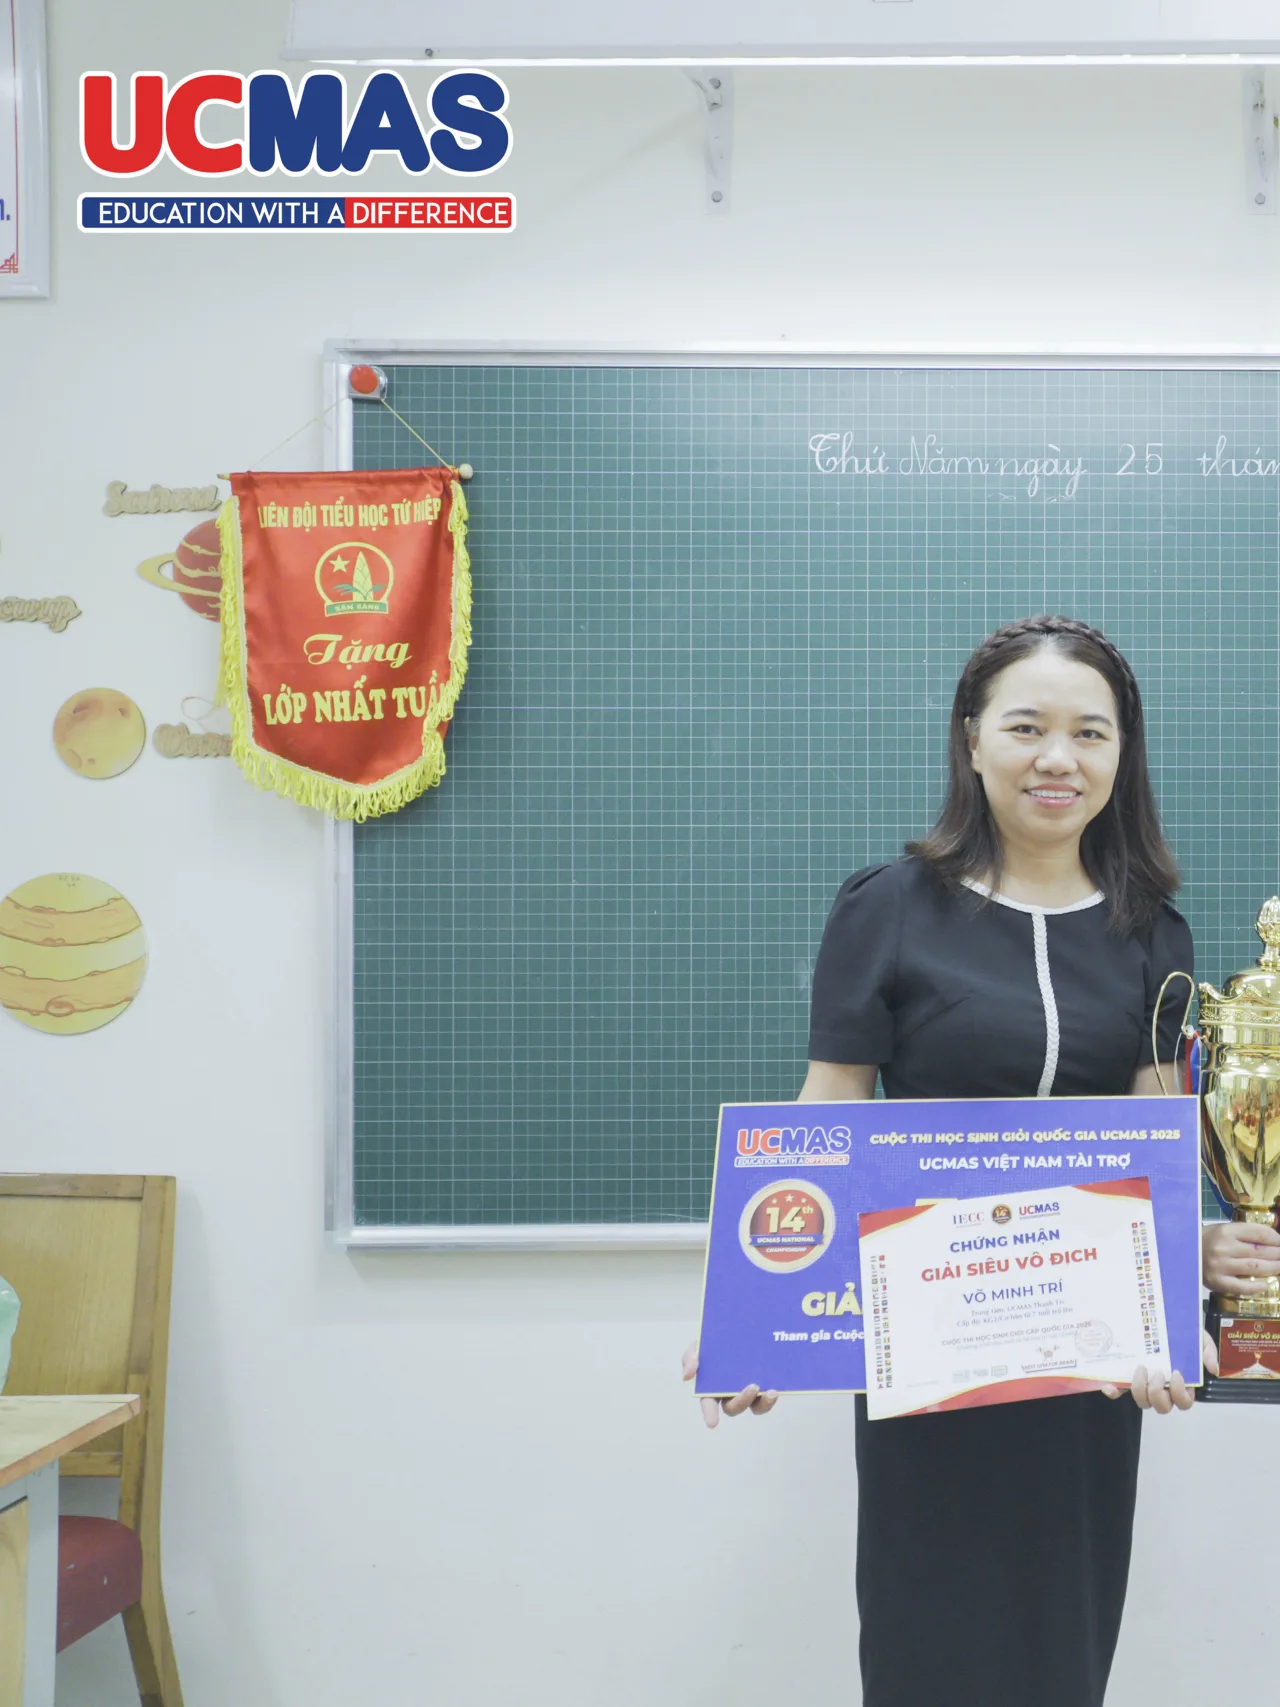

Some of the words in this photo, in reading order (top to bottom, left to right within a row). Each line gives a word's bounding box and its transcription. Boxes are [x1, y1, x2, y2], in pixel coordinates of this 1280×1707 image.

[808, 431, 890, 475] Thứ
[899, 434, 990, 476] Năm
[995, 443, 1088, 497] ngày
[1115, 442, 1164, 476] 25
[257, 501, 289, 529] LIÊN
[292, 501, 317, 532] ĐỘI
[320, 496, 354, 527] TIỂU
[358, 503, 389, 531] HỌC
[391, 498, 411, 526] TỨ
[413, 494, 442, 526] HIỆP
[303, 633, 413, 670] Tặng
[262, 683, 308, 725] LỚP
[312, 675, 387, 723] NHẤT
[737, 1126, 852, 1155] UCMAS
[869, 1132, 908, 1147] CUỘC
[911, 1132, 933, 1144] THI
[935, 1132, 965, 1146] HỌC
[967, 1131, 999, 1143] SINH
[1001, 1128, 1030, 1142] GIỎI
[1032, 1128, 1071, 1144] QUỐC
[1074, 1130, 1097, 1141] GIA
[1100, 1129, 1148, 1141] UCMAS
[1150, 1129, 1181, 1141] 2025
[738, 1157, 777, 1167] EDUCATION
[779, 1157, 798, 1165] WITH
[805, 1155, 847, 1165] DIFFERENCE
[919, 1156, 980, 1171] UCMAS
[982, 1153, 1020, 1172] VIỆT
[1023, 1155, 1062, 1169] NAM
[1066, 1152, 1093, 1168] TÀI
[1096, 1152, 1131, 1171] TRỢ
[765, 1205, 814, 1234] 14th
[951, 1211, 985, 1225] IECC
[1019, 1201, 1060, 1216] UCMAS
[757, 1236, 781, 1244] UCMAS
[781, 1235, 815, 1244] NATIONAL
[950, 1235, 1008, 1253] CHỨNG
[1013, 1228, 1061, 1246] NHẬN
[921, 1261, 961, 1282] GIẢI
[966, 1257, 1010, 1276] SIÊU
[1014, 1251, 1044, 1270] VÔ
[1049, 1247, 1098, 1267] ĐỊCH
[801, 1281, 863, 1317] GIẢ
[963, 1289, 987, 1305] VÕ
[991, 1285, 1034, 1302] MINH
[1038, 1278, 1063, 1295] TRÍ
[772, 1330, 809, 1342] Tham
[810, 1329, 831, 1343] gia
